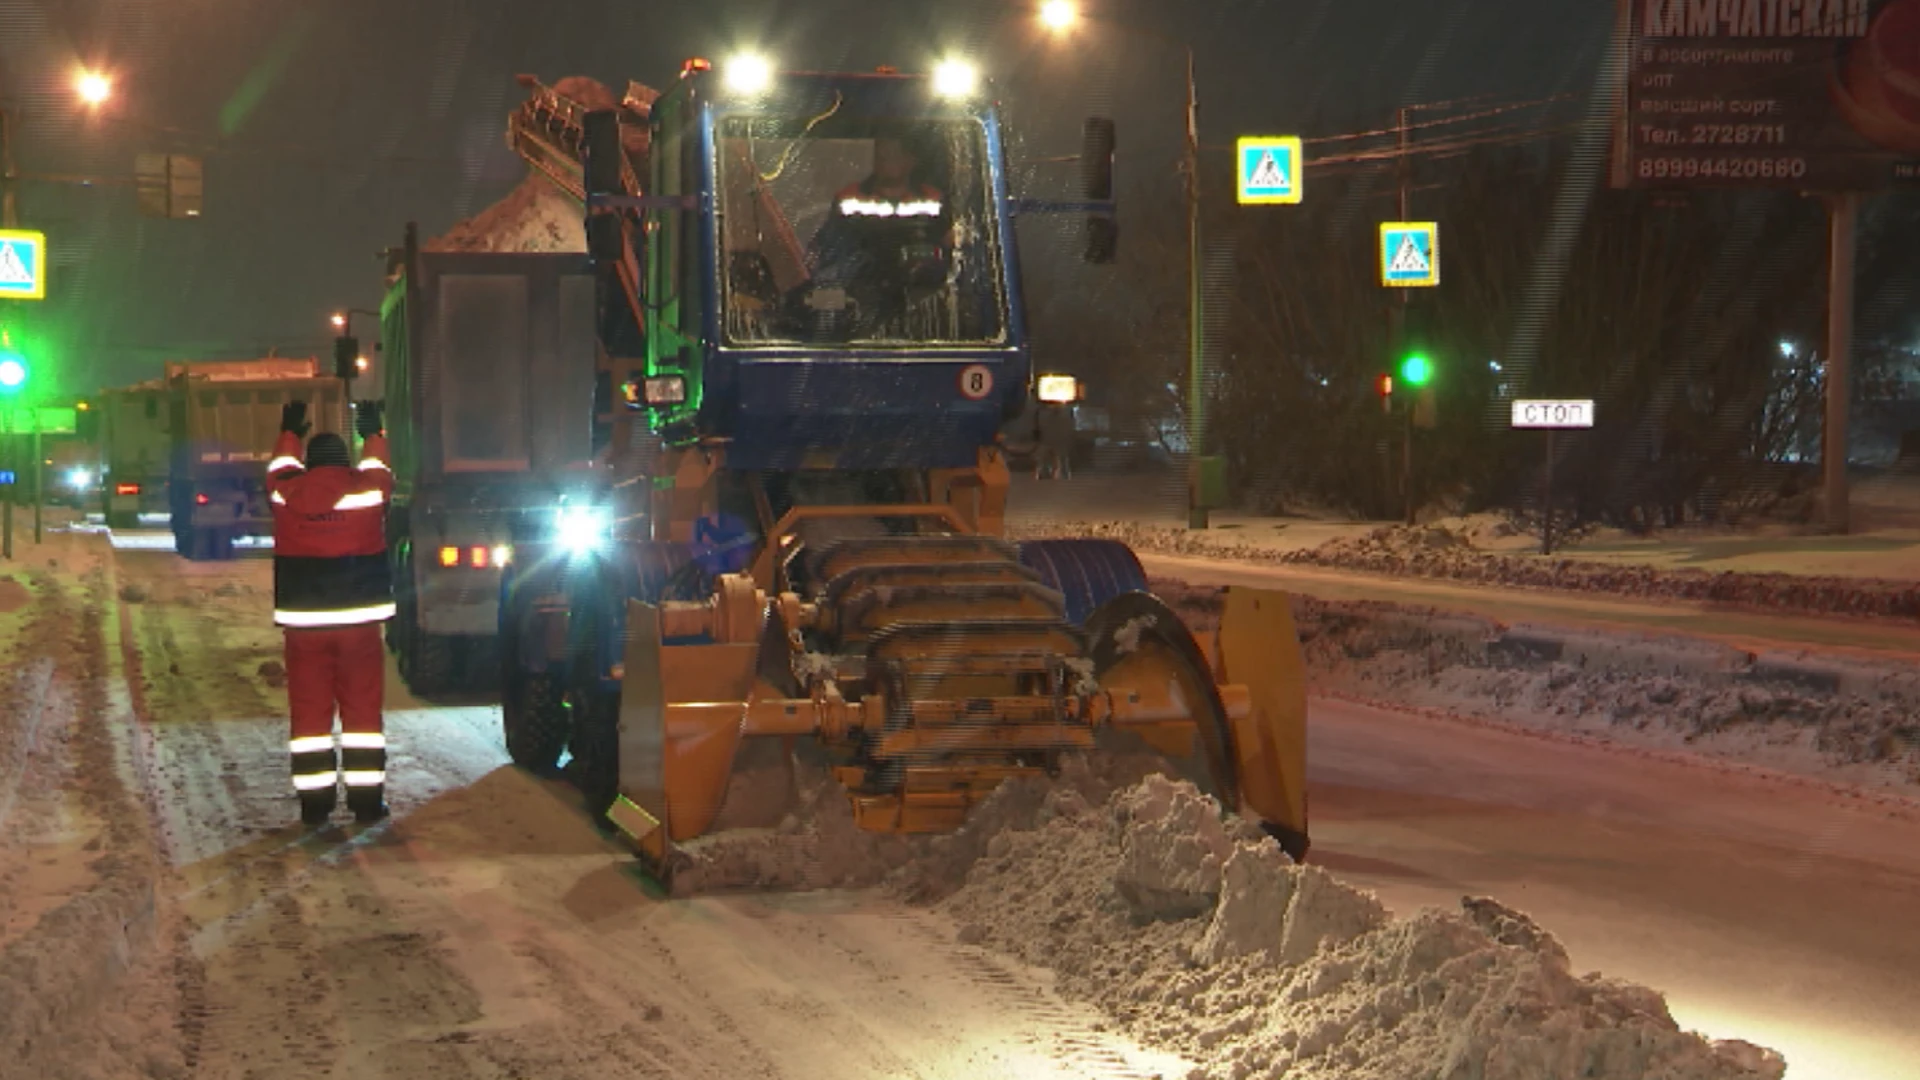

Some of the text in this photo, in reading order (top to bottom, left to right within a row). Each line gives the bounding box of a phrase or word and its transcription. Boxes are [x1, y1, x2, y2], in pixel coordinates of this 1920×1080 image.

[1643, 0, 1868, 37] КАМЧАТСКАЯ
[1640, 98, 1776, 116] высший сорт
[1640, 124, 1785, 144] Тел. 2728711
[1639, 158, 1806, 177] 89994420660
[1525, 404, 1582, 423] СТОП
